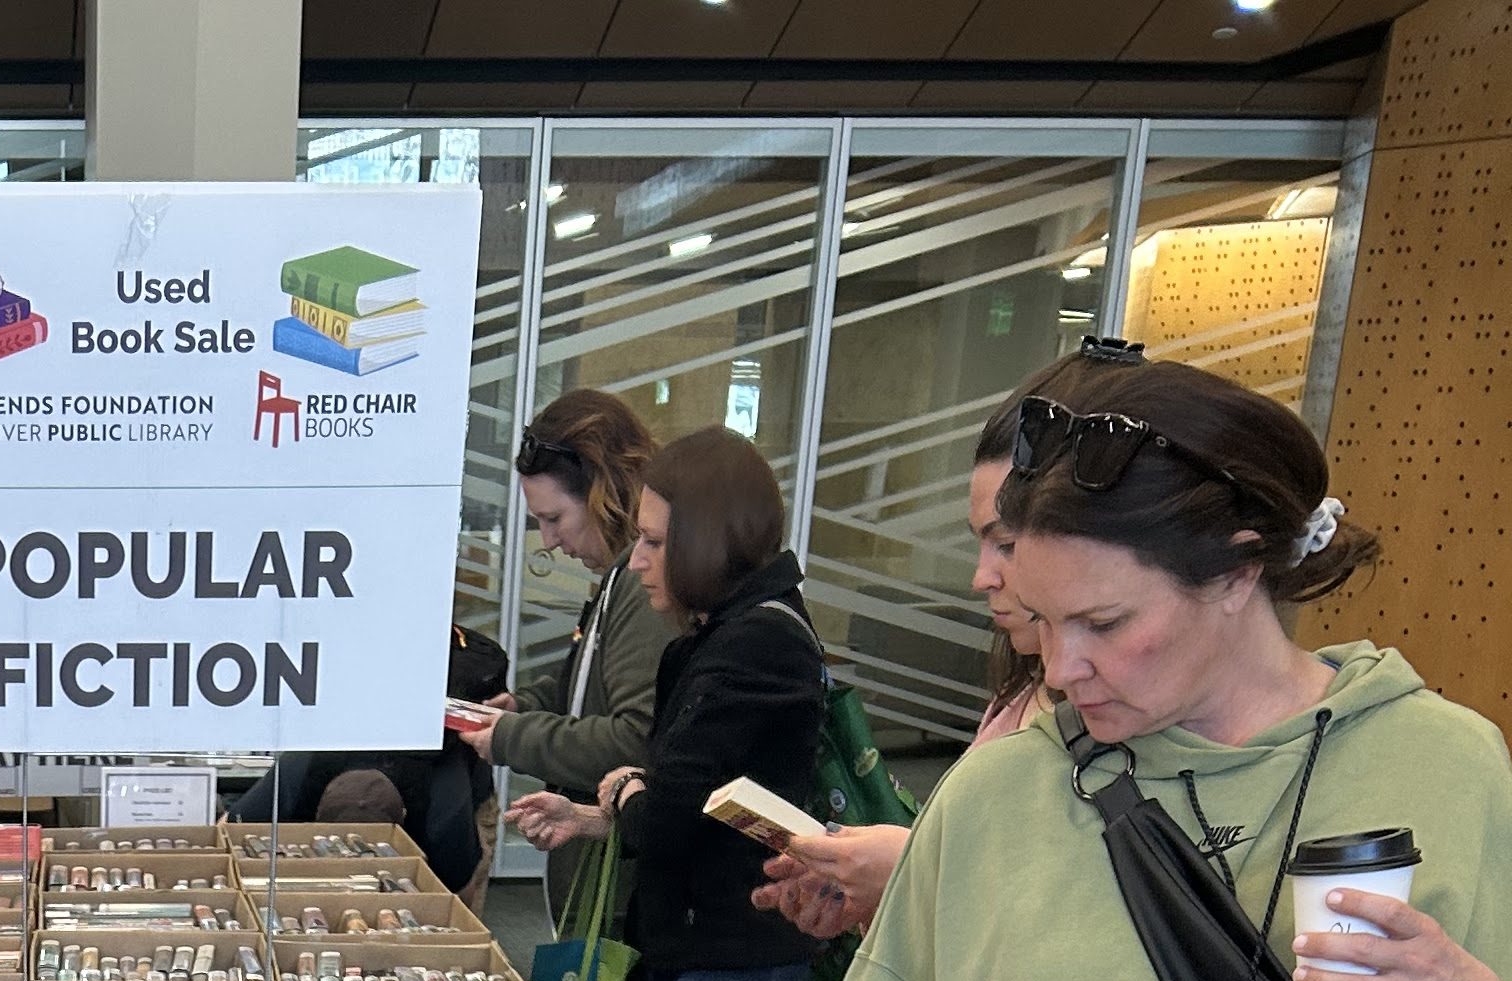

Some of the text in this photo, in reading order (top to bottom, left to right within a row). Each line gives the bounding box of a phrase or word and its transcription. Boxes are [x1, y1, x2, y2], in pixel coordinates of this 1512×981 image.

[116, 271, 210, 303] Used
[72, 321, 255, 354] Book Sale
[61, 396, 214, 415] FOUNDATION
[307, 393, 417, 414] RED CHAIR
[47, 424, 122, 442] PUBLIC
[128, 424, 213, 442] LIBRARY
[306, 418, 374, 438] BOOKS
[1210, 825, 1245, 845] NIKE
